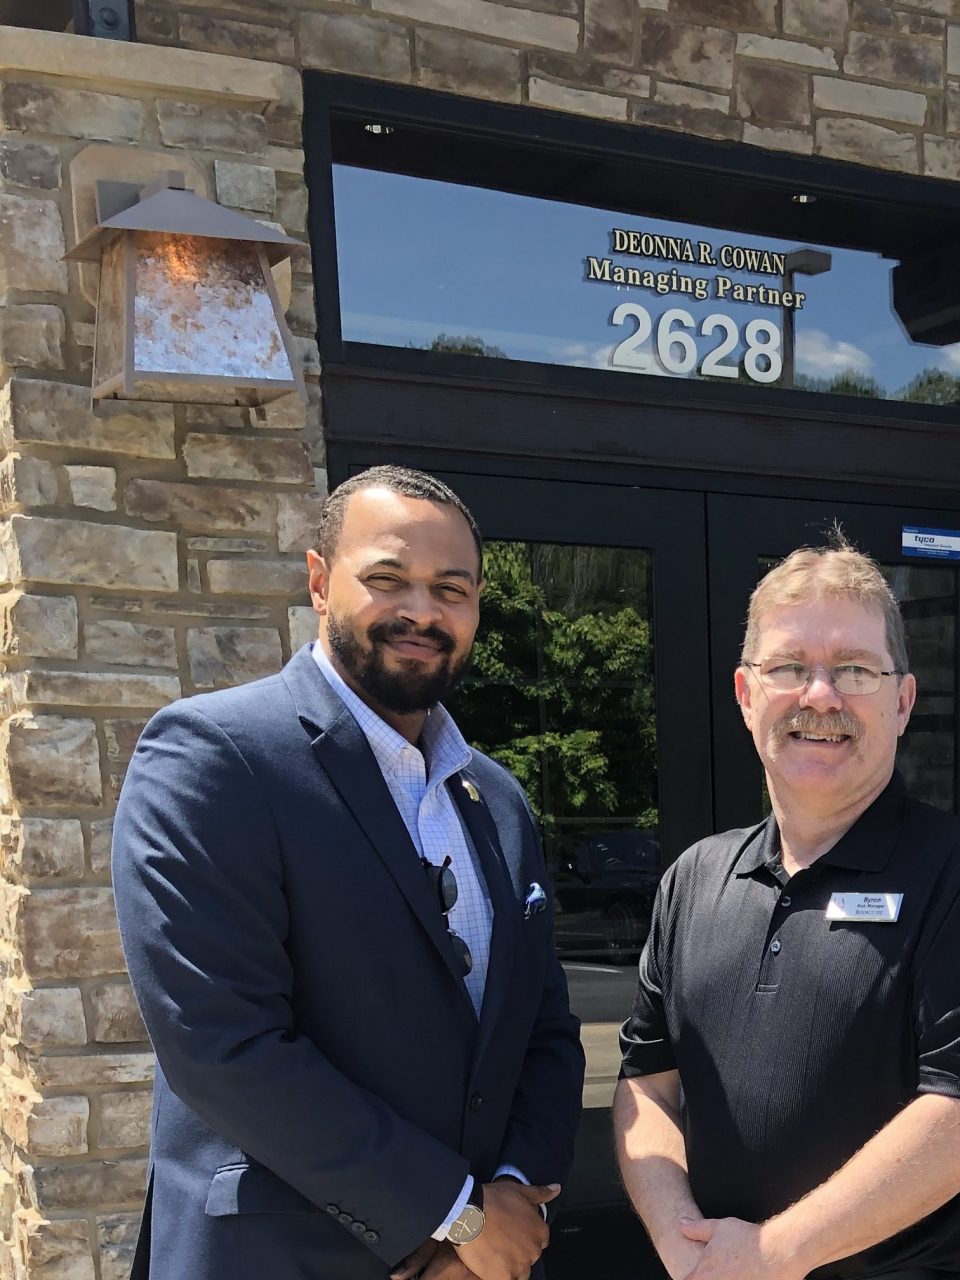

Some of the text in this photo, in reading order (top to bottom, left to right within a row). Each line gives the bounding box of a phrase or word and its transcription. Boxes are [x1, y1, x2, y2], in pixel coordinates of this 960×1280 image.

[613, 229, 786, 276] DEONNA R. COWAN
[588, 257, 805, 309] Managing Partner
[612, 302, 783, 383] 2628
[914, 535, 935, 544] tyco
[863, 896, 882, 904] Byron
